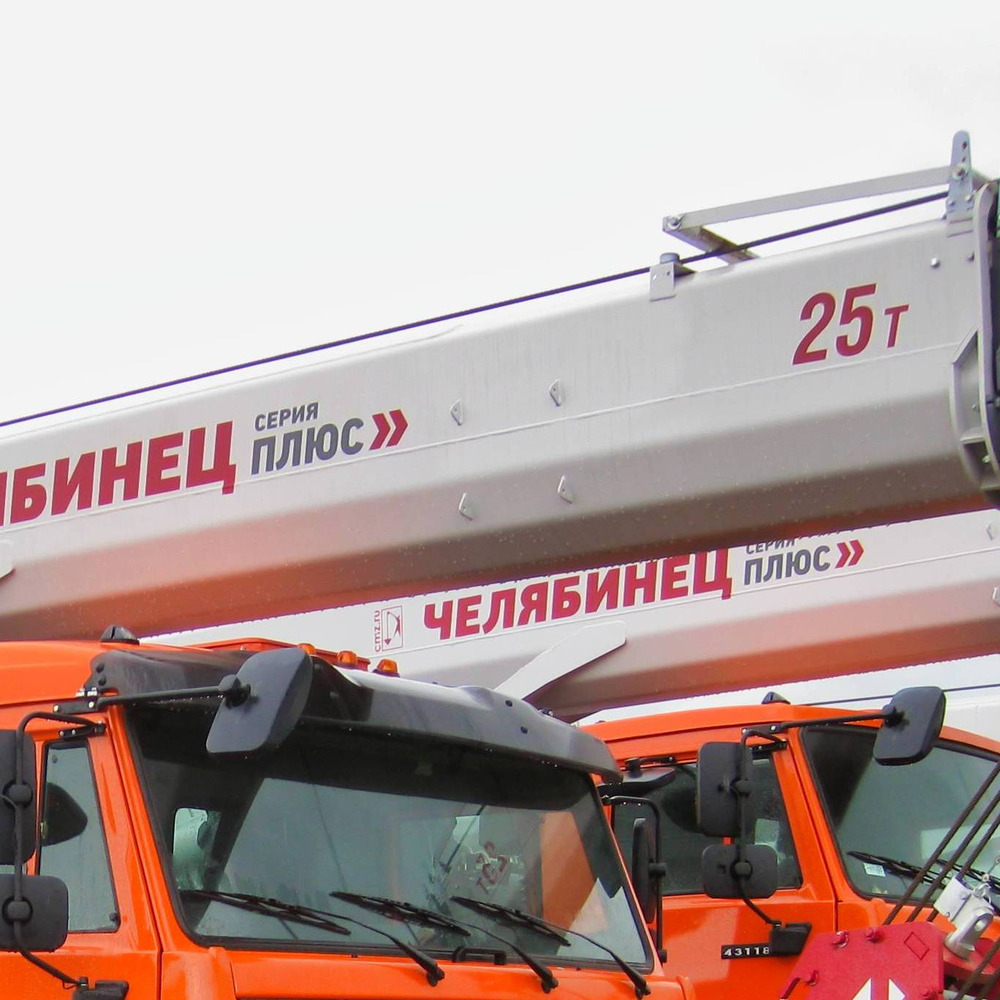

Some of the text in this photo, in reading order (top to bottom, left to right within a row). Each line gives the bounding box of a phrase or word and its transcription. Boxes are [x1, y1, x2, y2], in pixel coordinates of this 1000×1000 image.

[254, 401, 319, 432] СЕРИЯ
[251, 417, 364, 475] ПЛЮС
[744, 545, 831, 586] ПЛЮС
[424, 550, 732, 640] ЧЕЛЯБИНЕЦ
[724, 946, 770, 956] 43118
